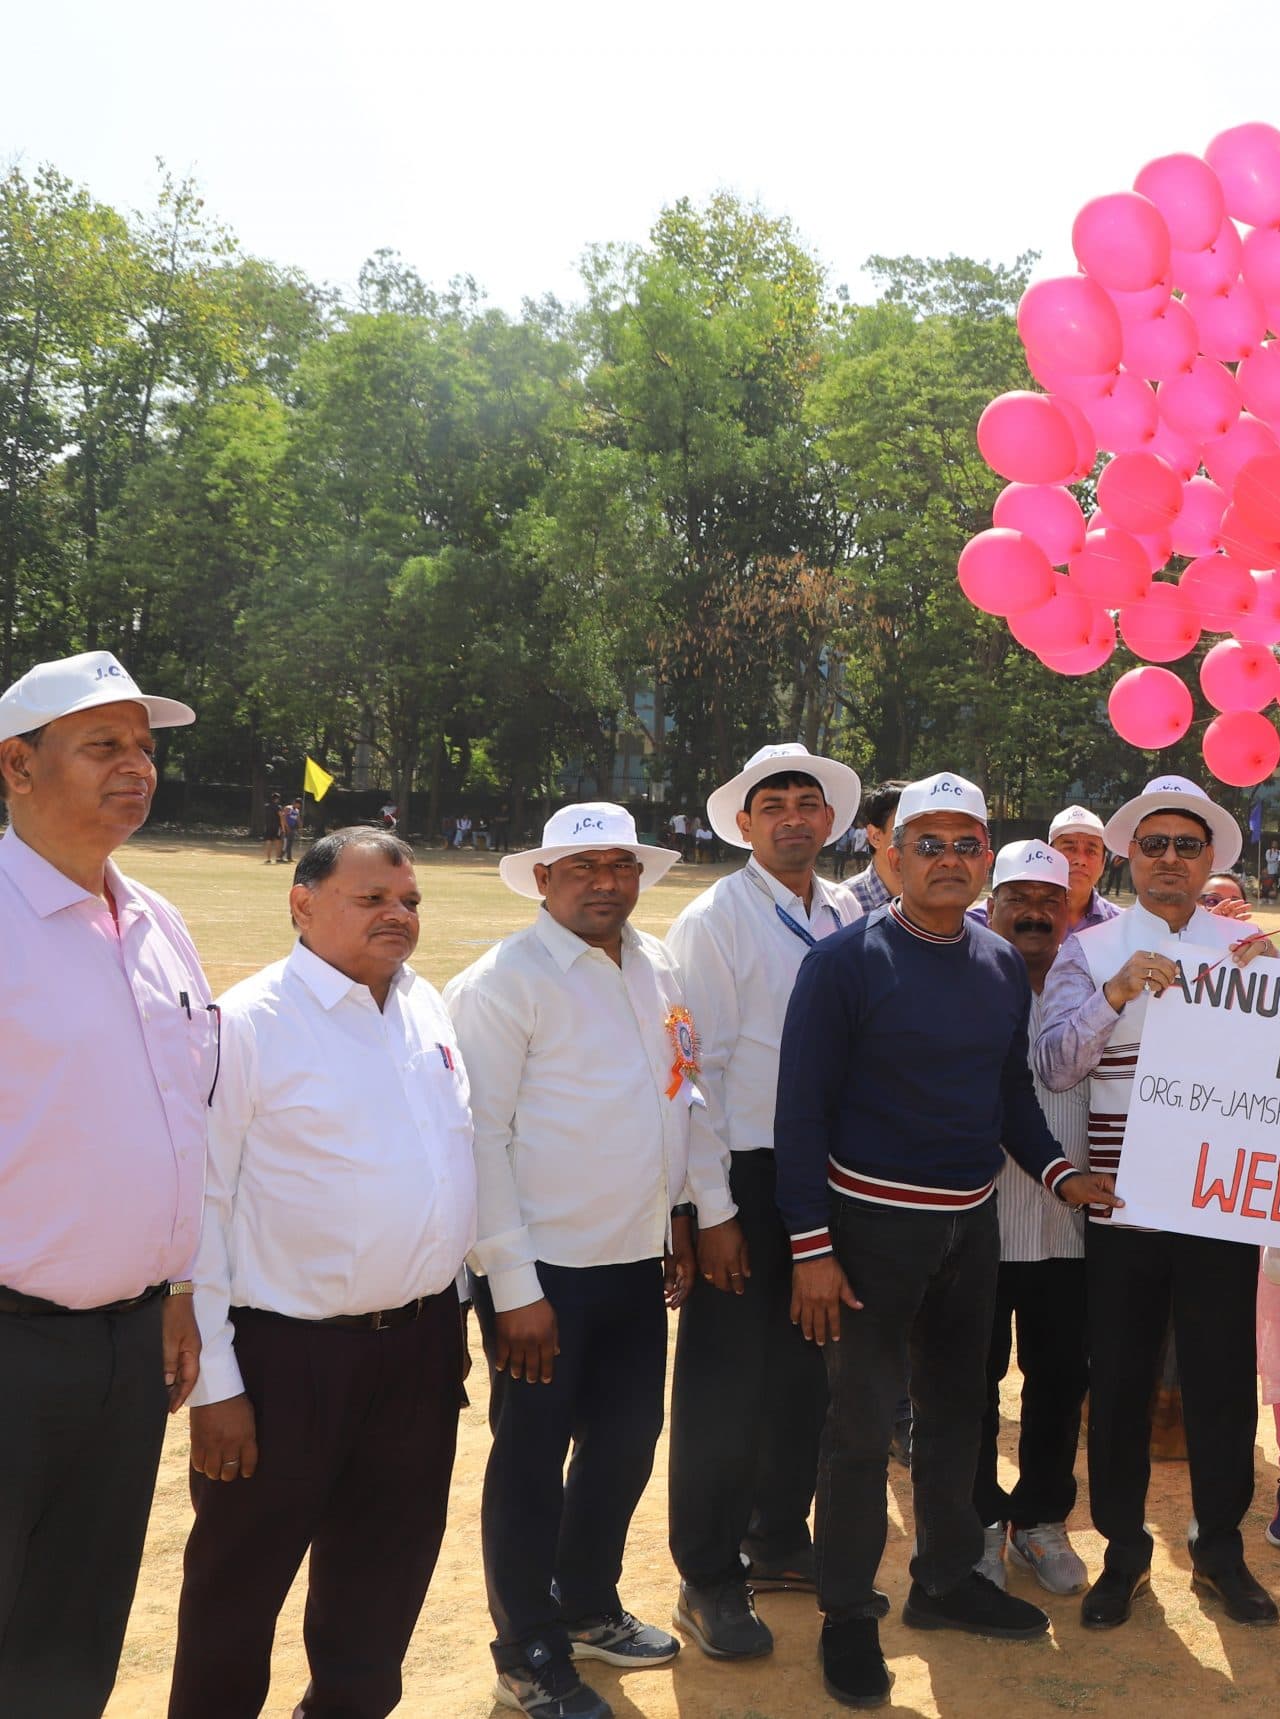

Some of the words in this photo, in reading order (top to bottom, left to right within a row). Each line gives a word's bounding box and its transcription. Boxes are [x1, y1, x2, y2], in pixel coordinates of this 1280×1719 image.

[94, 664, 131, 682] J.C.
[930, 782, 964, 796] J.C.C
[1139, 1075, 1184, 1108] ORG.
